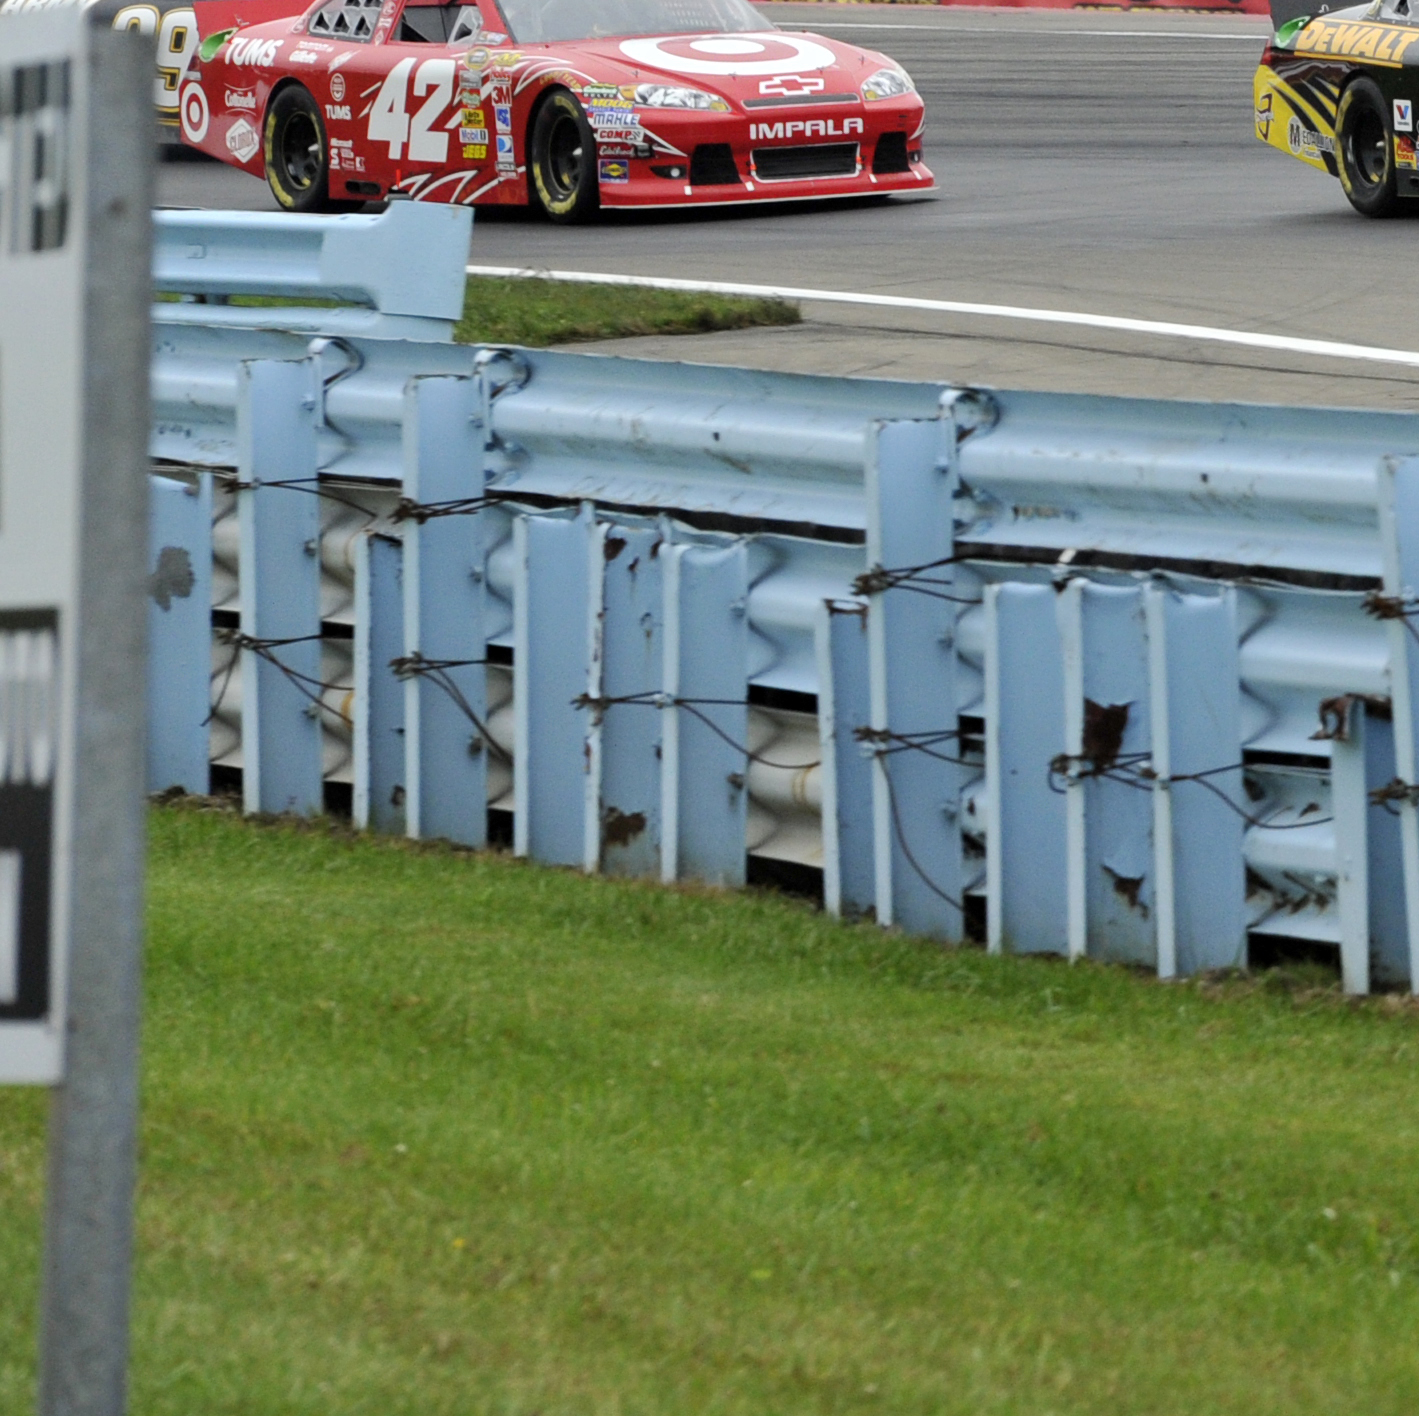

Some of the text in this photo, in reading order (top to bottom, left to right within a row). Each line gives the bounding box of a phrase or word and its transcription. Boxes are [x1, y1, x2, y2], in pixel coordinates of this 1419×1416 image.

[225, 37, 284, 67] TUMS
[492, 85, 512, 105] 3M
[592, 98, 633, 108] MOOG
[325, 104, 352, 120] TUMS
[367, 57, 456, 163] 42
[593, 113, 639, 125] MAHLE
[599, 130, 632, 139] COMP
[749, 117, 864, 140] IMPALA
